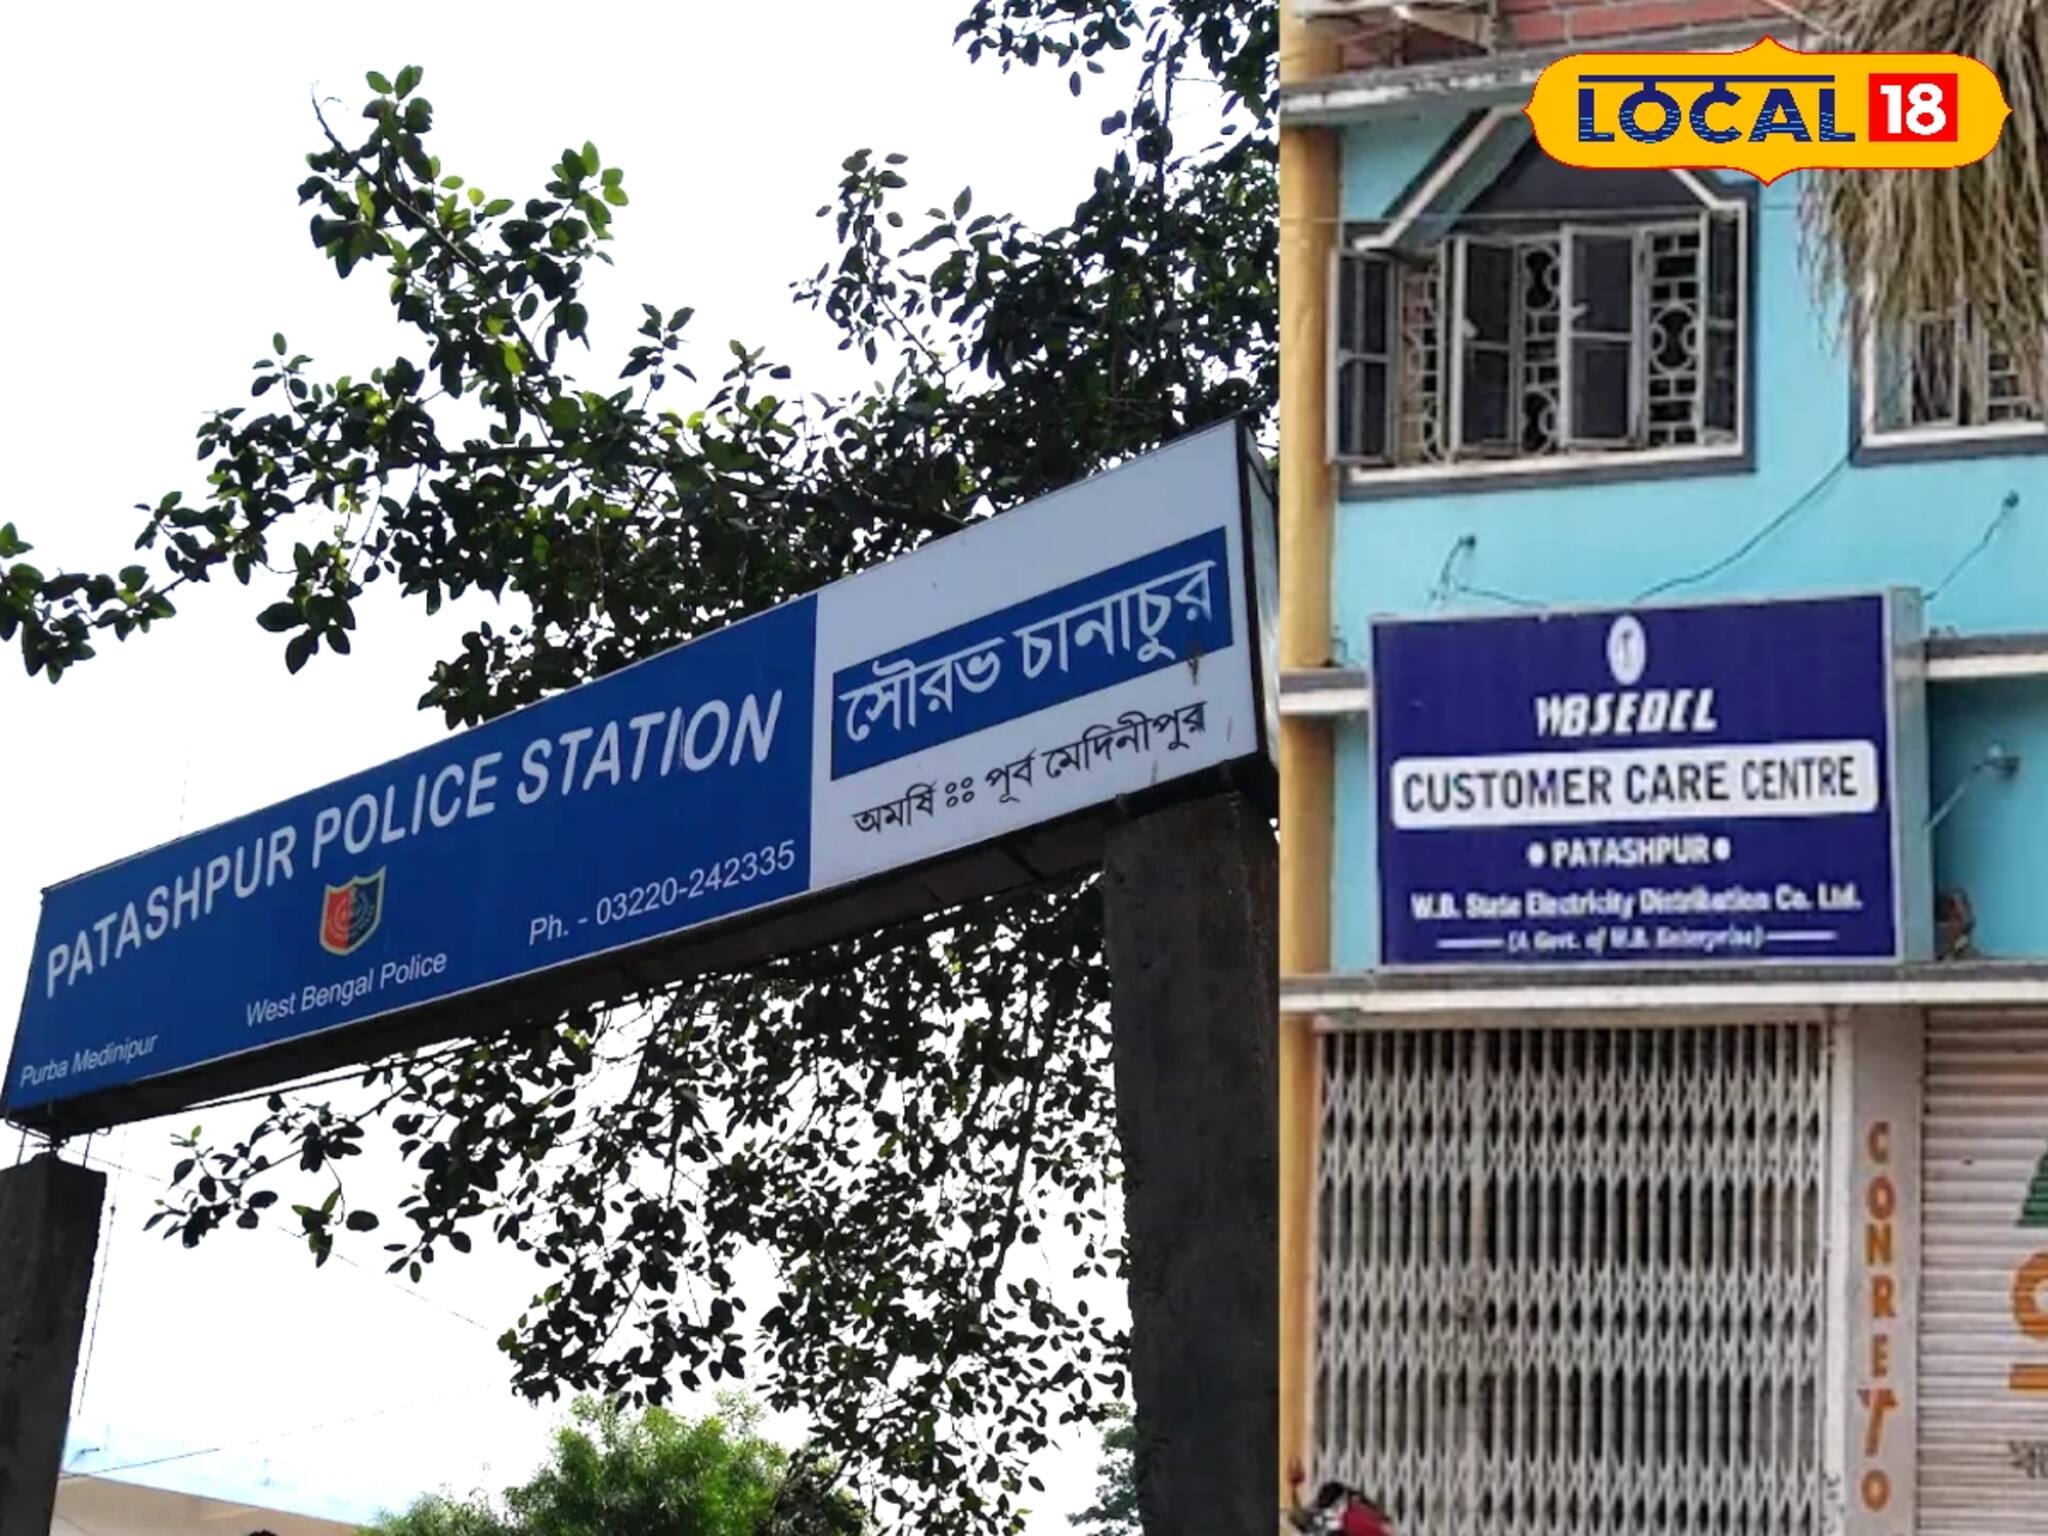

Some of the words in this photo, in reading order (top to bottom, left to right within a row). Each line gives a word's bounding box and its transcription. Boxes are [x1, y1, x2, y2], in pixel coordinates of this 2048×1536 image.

[838, 637, 1006, 742] সৌরভ
[1012, 558, 1218, 679] চানাচুর
[851, 777, 941, 834] অমর্ষি
[985, 747, 1040, 803] পূর্ব
[1041, 700, 1208, 780] মেদিনীপুর
[1403, 767, 1612, 813] CUSTOMER
[1625, 760, 1729, 805] CARE
[1741, 755, 1857, 801] CENTRE
[46, 824, 297, 999] PATASHPUR
[312, 751, 503, 869] POLICE
[516, 689, 783, 805] STATION
[1551, 835, 1713, 868] PATASHPUR
[529, 913, 570, 947] Ph.
[595, 840, 796, 927] 03220-242335
[1466, 891, 1522, 918] State
[1525, 888, 1634, 921] Electricity
[1639, 885, 1771, 914] Distribution
[1775, 882, 1813, 910] Co.
[1584, 925, 1608, 955] of
[246, 991, 296, 1027] West
[301, 968, 374, 1012] Bengal
[380, 951, 447, 991] Police
[20, 1055, 68, 1090] Purba
[72, 1031, 159, 1076] Medinipur
